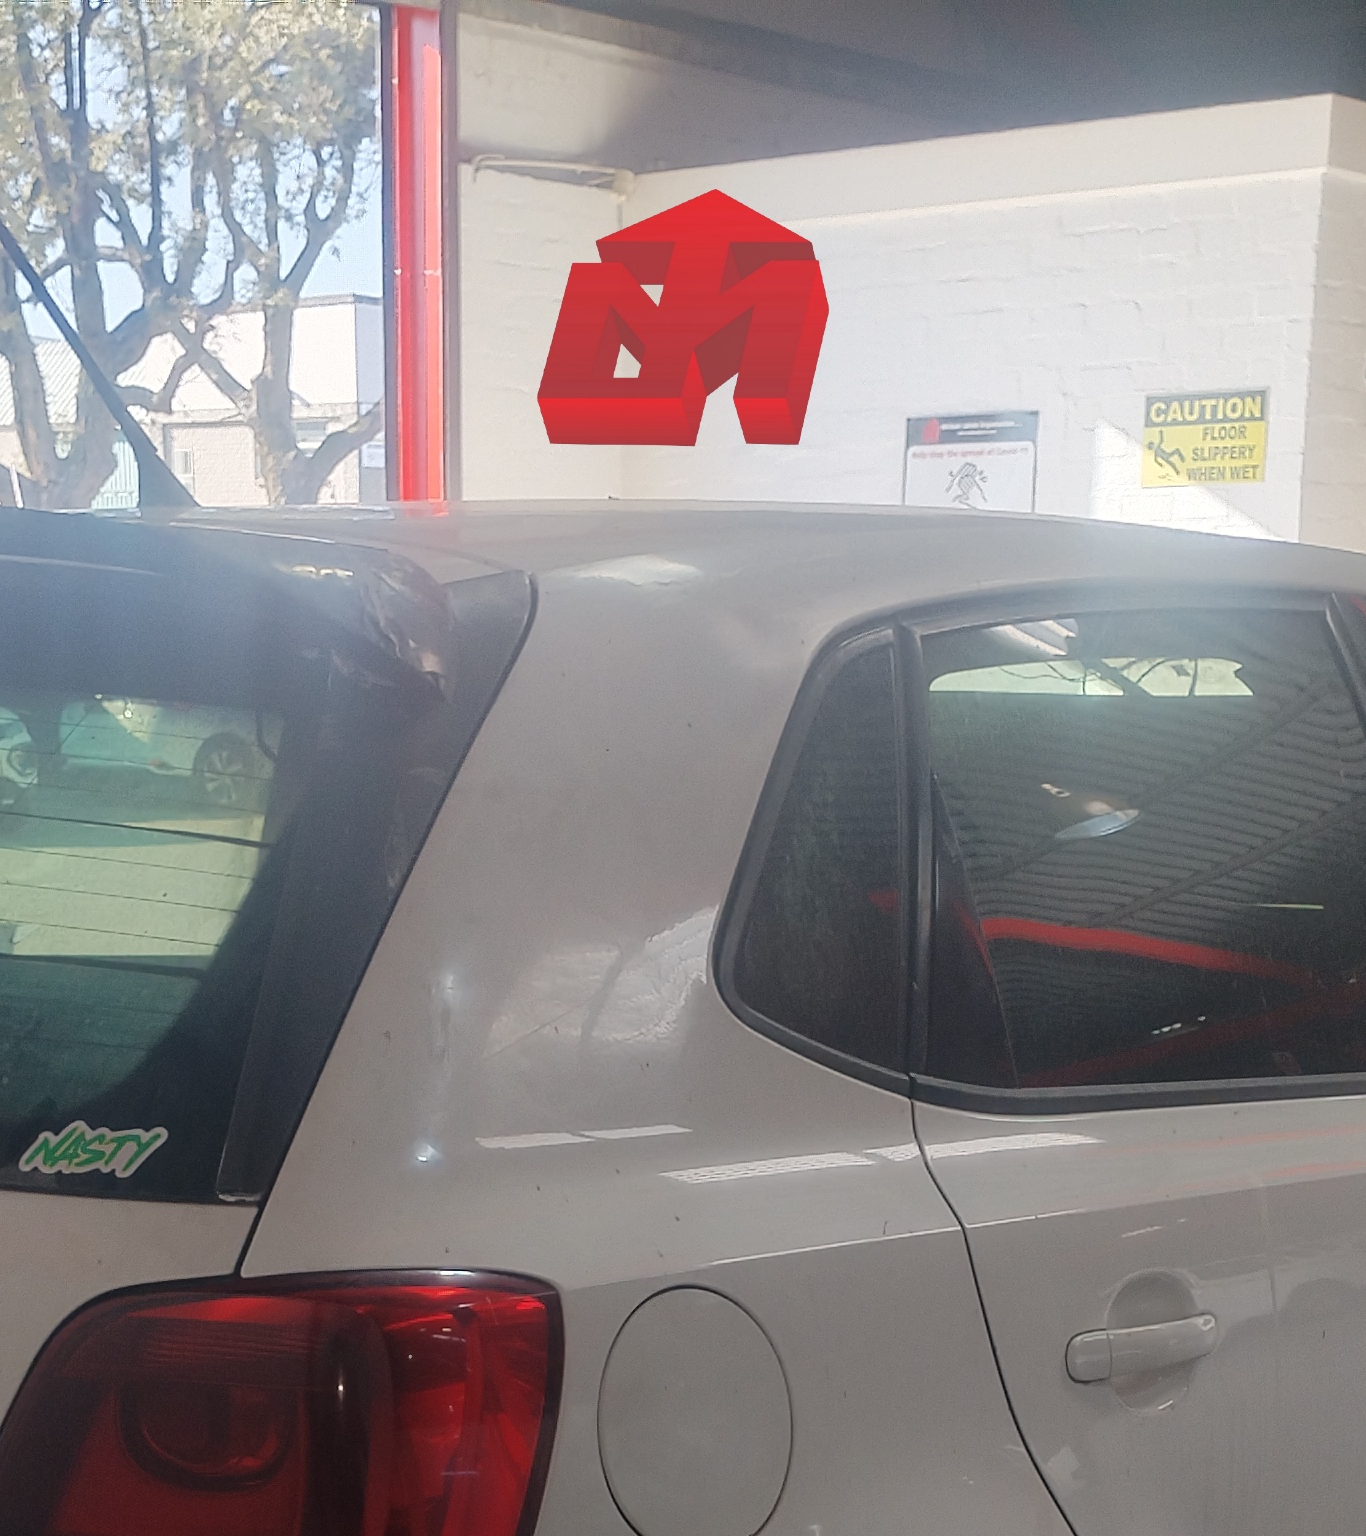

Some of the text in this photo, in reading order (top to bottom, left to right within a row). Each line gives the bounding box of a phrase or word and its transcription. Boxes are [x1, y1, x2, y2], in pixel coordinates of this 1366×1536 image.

[1149, 396, 1262, 423] CAUTION
[1202, 425, 1247, 441] FLOOR
[1191, 444, 1257, 461] SLIPPERY
[1186, 464, 1260, 481] WHEN WET
[23, 1124, 163, 1173] NASTY
